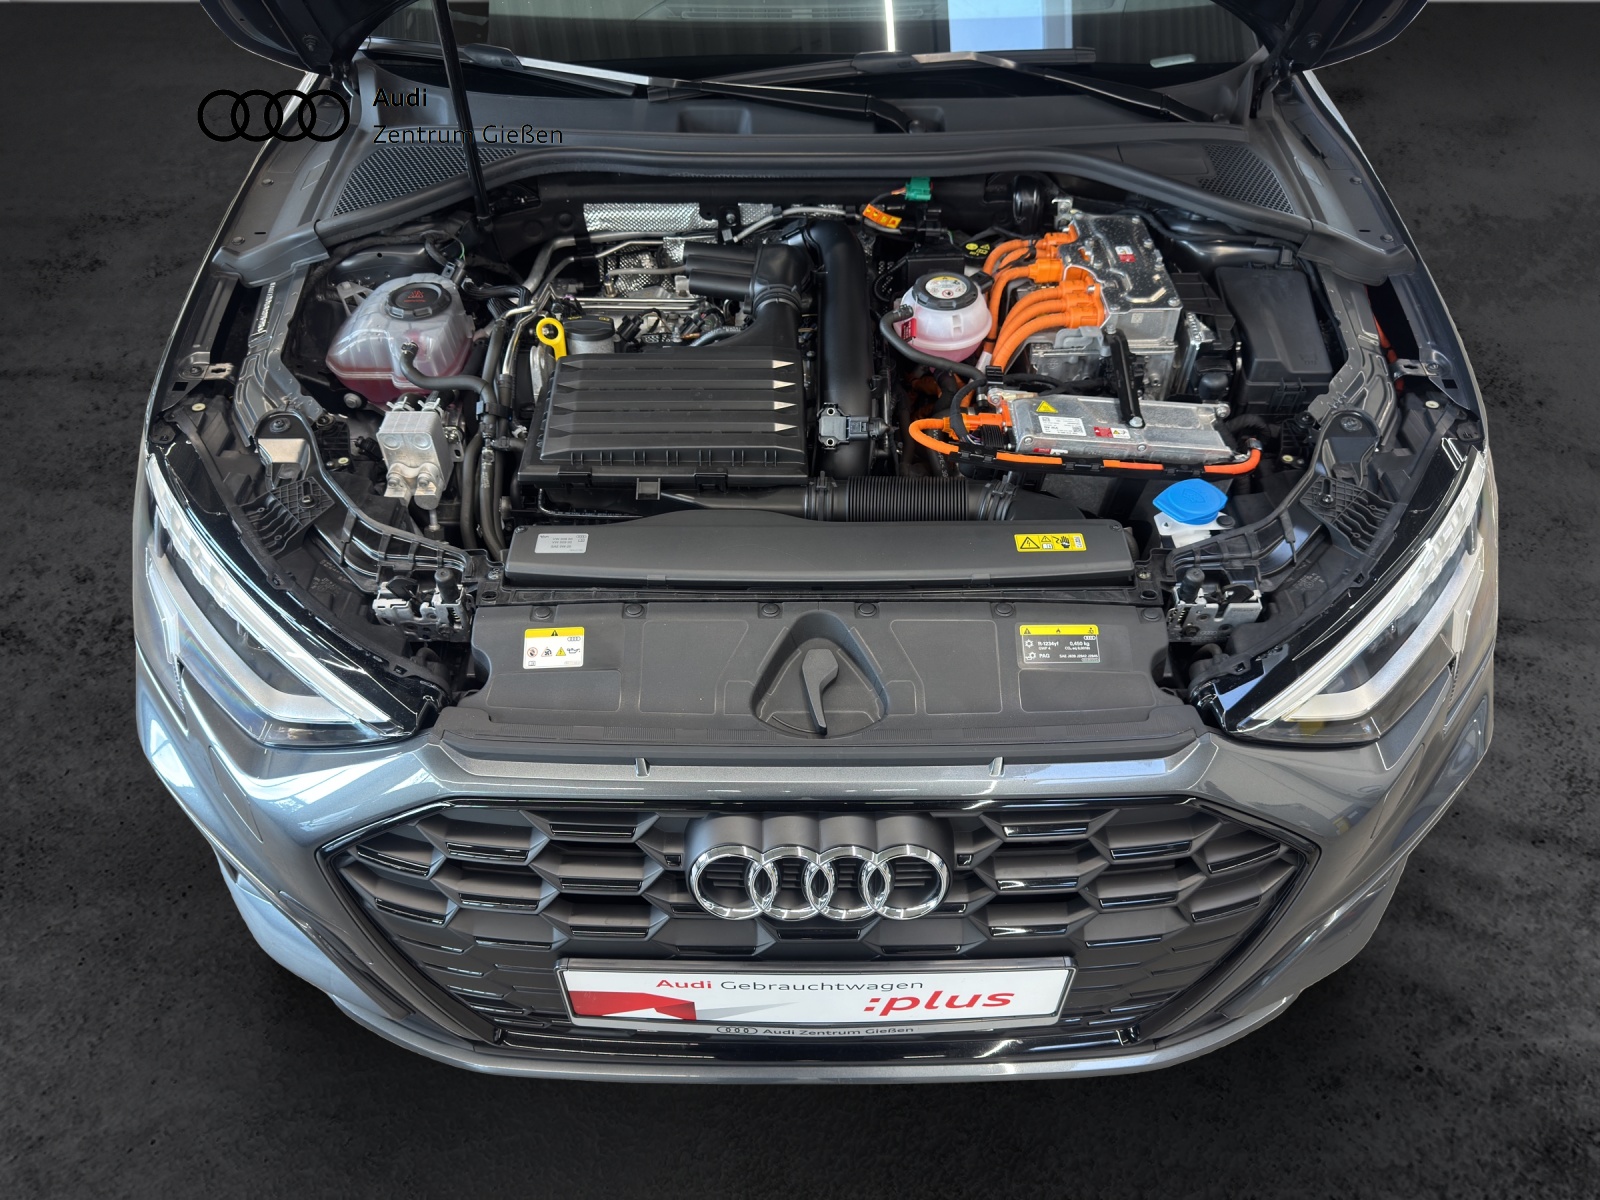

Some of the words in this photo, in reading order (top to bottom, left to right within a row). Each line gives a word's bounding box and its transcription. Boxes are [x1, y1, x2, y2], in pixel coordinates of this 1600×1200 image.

[656, 979, 712, 989] Audi
[720, 981, 923, 992] Gebrauchtwagen
[865, 1027, 914, 1035] Gießen
